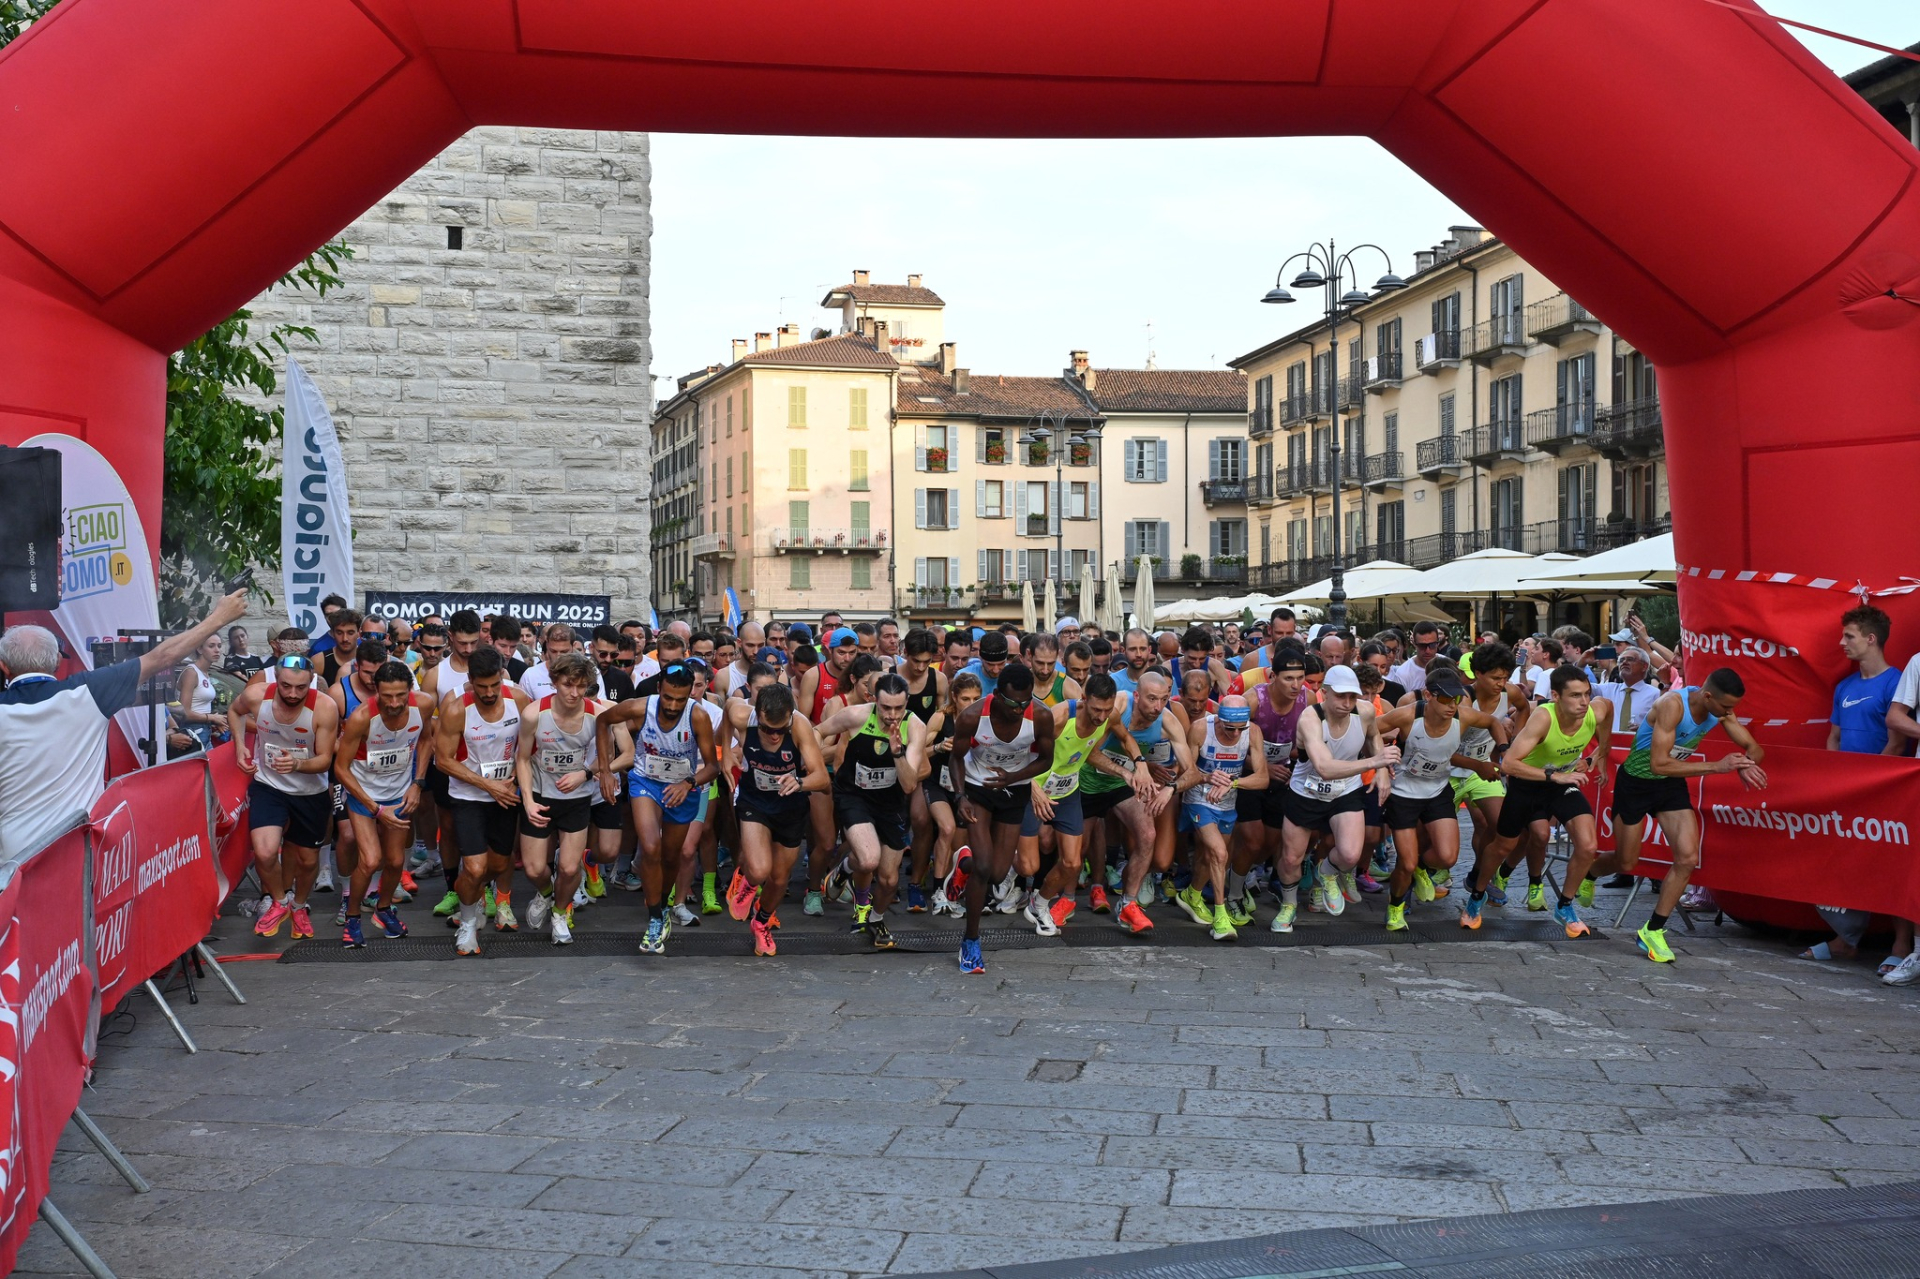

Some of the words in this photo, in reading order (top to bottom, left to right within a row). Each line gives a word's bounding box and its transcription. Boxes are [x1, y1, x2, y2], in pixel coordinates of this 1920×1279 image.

[77, 511, 118, 545] CIAO
[115, 562, 124, 576] .IT
[370, 602, 435, 618] COMO
[510, 604, 551, 619] RUN
[558, 605, 605, 621] 2025
[1267, 747, 1281, 756] 35
[379, 754, 397, 766] 110
[553, 754, 574, 764] 126
[494, 766, 508, 778] 111
[664, 762, 672, 772] 2
[1422, 762, 1438, 771] 88
[866, 771, 885, 780] 141
[1055, 778, 1072, 788] 108
[1317, 782, 1332, 794] 66
[1712, 801, 1910, 846] maxisport.com
[97, 832, 132, 904] MAXI
[138, 833, 202, 896] maxisport.com
[95, 901, 131, 967] PORT
[22, 938, 81, 1054] maxisport.com
